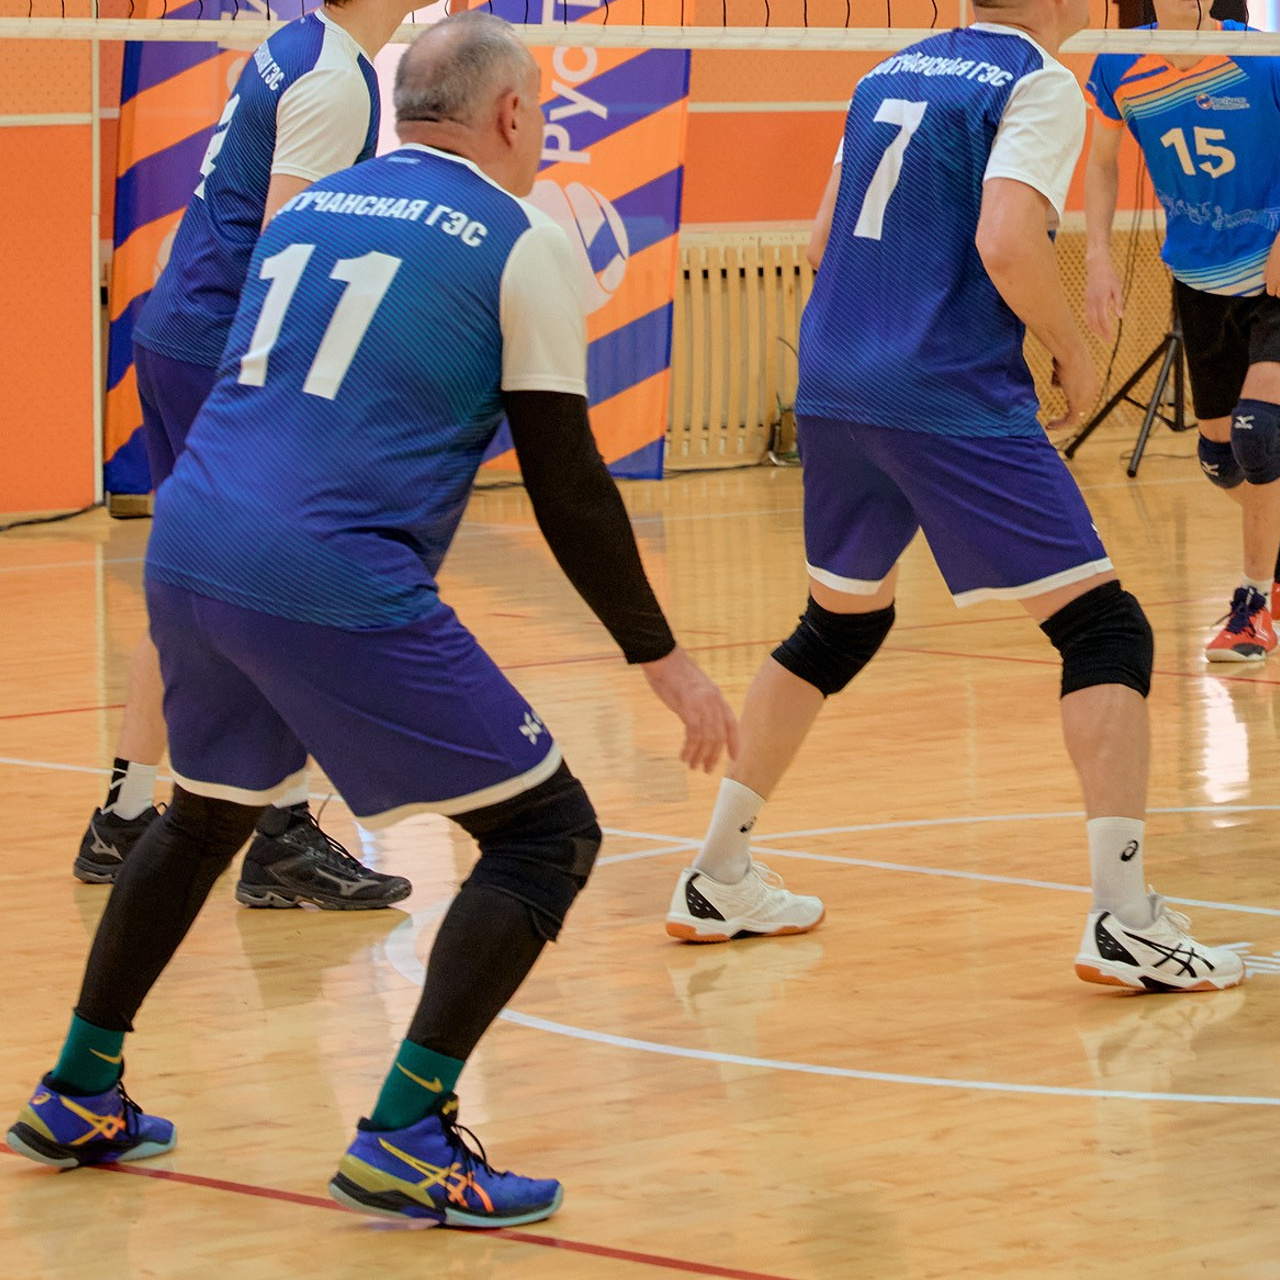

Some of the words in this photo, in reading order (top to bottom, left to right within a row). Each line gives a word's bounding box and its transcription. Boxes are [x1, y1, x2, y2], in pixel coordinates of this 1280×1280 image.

[261, 61, 285, 91] ГЭС
[968, 60, 1014, 88] ГЭС
[853, 97, 929, 241] 7
[1159, 125, 1237, 180] 15
[425, 204, 489, 249] ГЭС
[237, 242, 403, 401] 11
